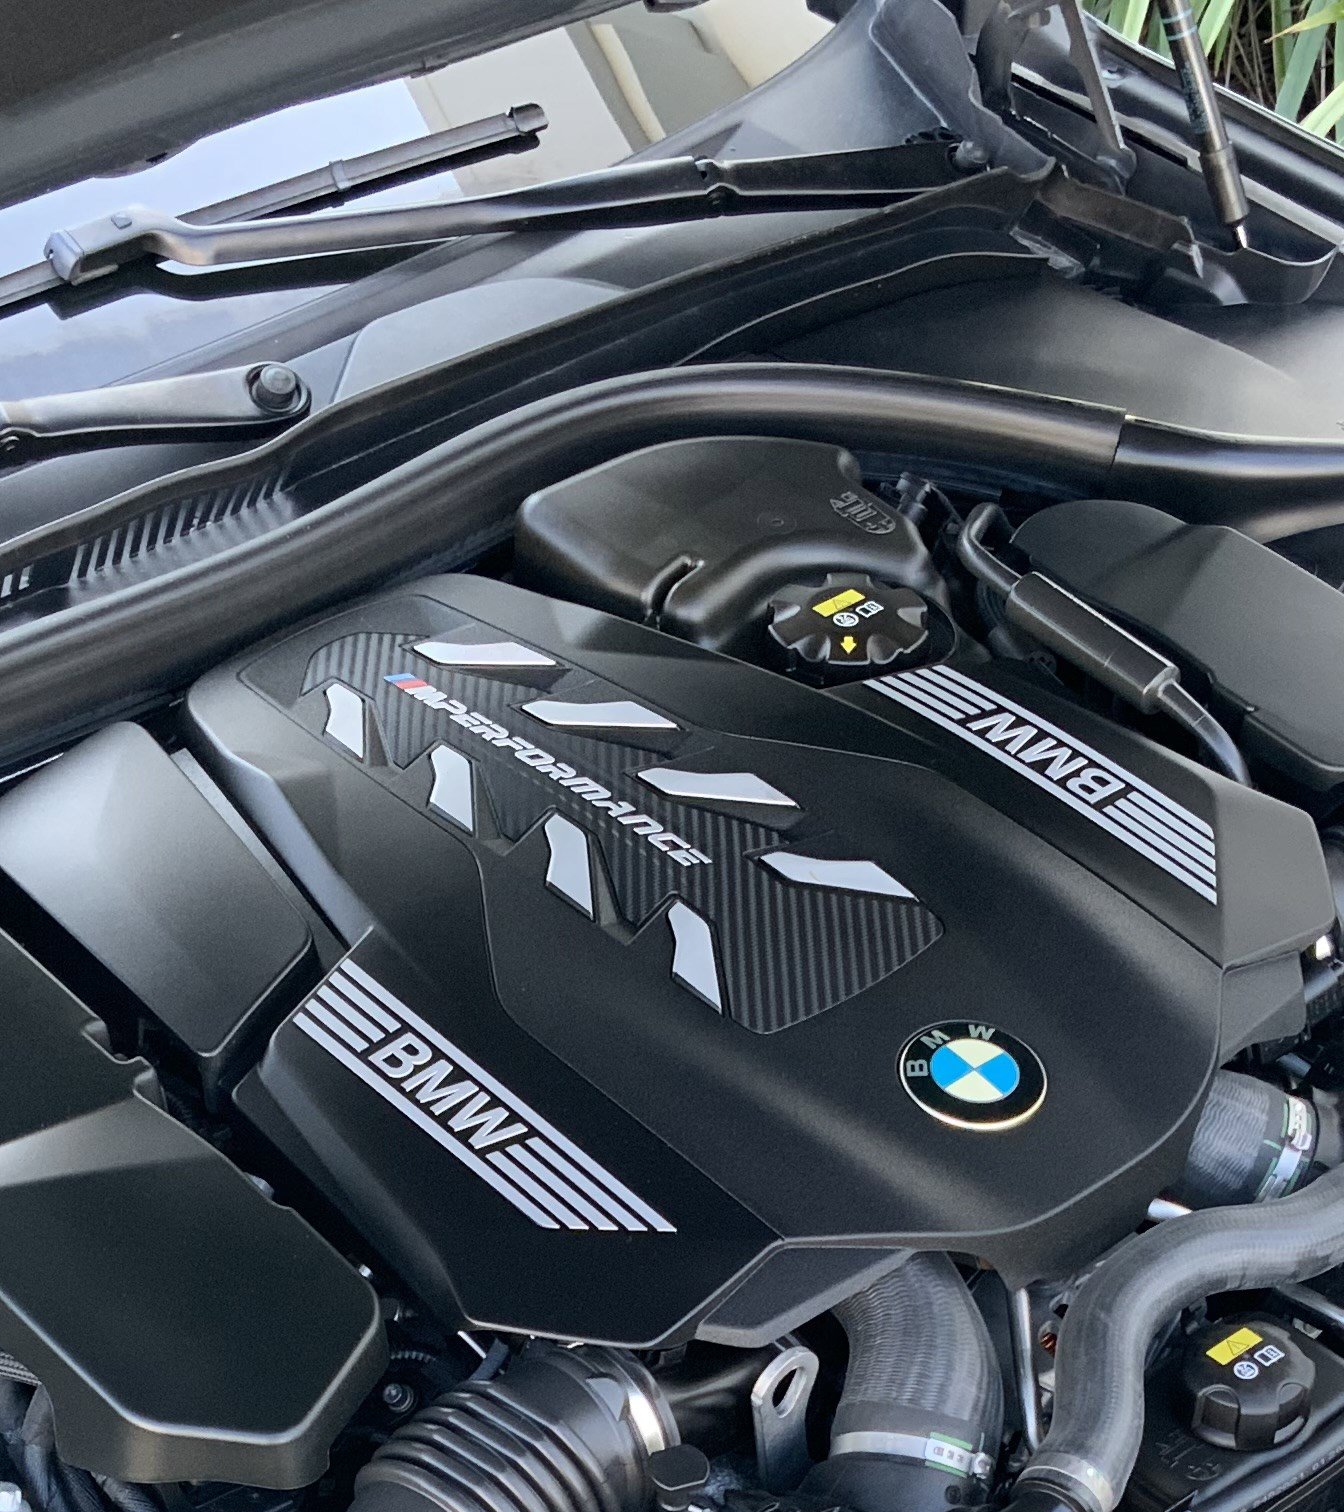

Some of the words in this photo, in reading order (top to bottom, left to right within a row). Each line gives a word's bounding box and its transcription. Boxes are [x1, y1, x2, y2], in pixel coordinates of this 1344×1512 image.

[431, 699, 713, 868] PERFORMANCE
[965, 711, 1126, 805] BMW
[367, 1031, 529, 1150] BMW
[905, 1023, 996, 1078] BMW
